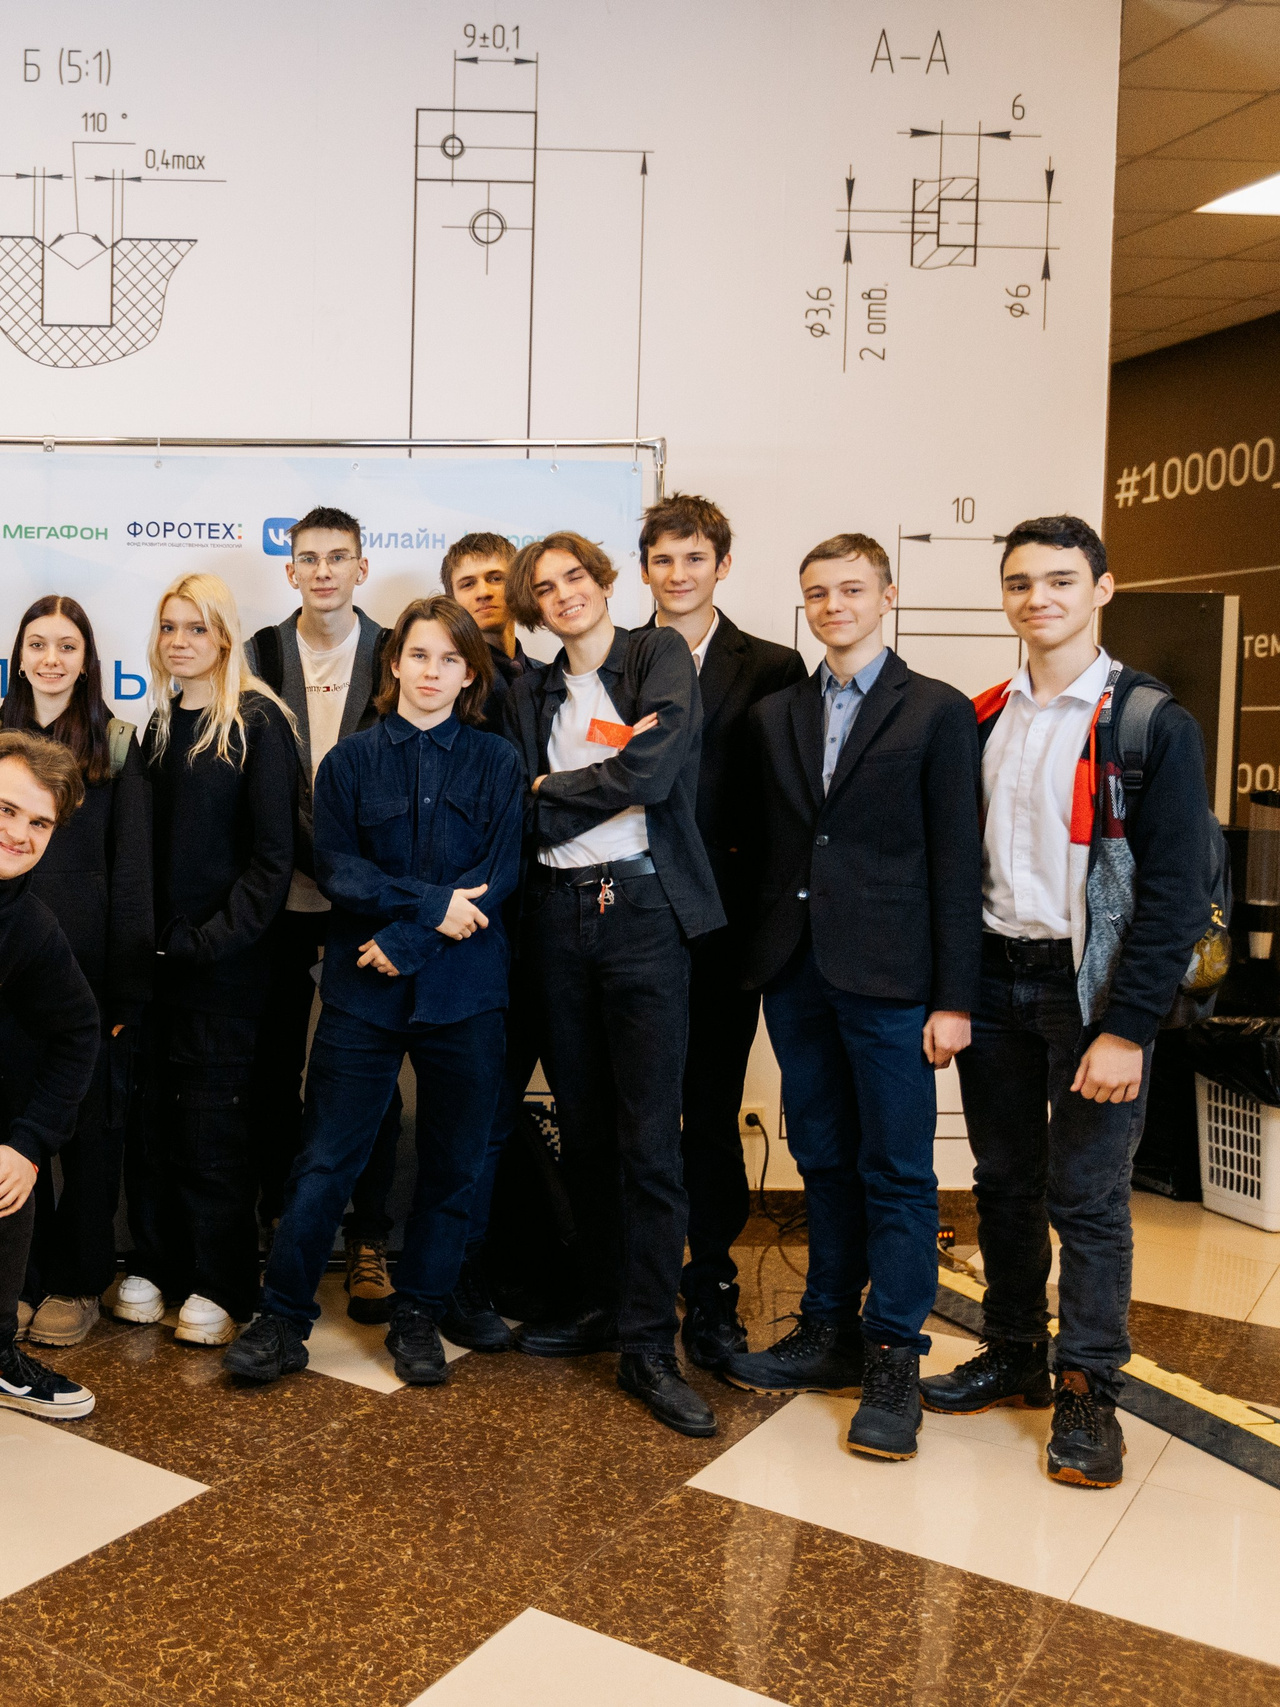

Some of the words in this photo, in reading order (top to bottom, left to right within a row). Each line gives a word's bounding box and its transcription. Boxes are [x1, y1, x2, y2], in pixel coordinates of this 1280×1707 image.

[23, 48, 41, 83] Б
[1011, 93, 1025, 121] 6
[144, 148, 206, 172] 0,4max
[858, 347, 887, 362] 2
[952, 496, 975, 524] 10
